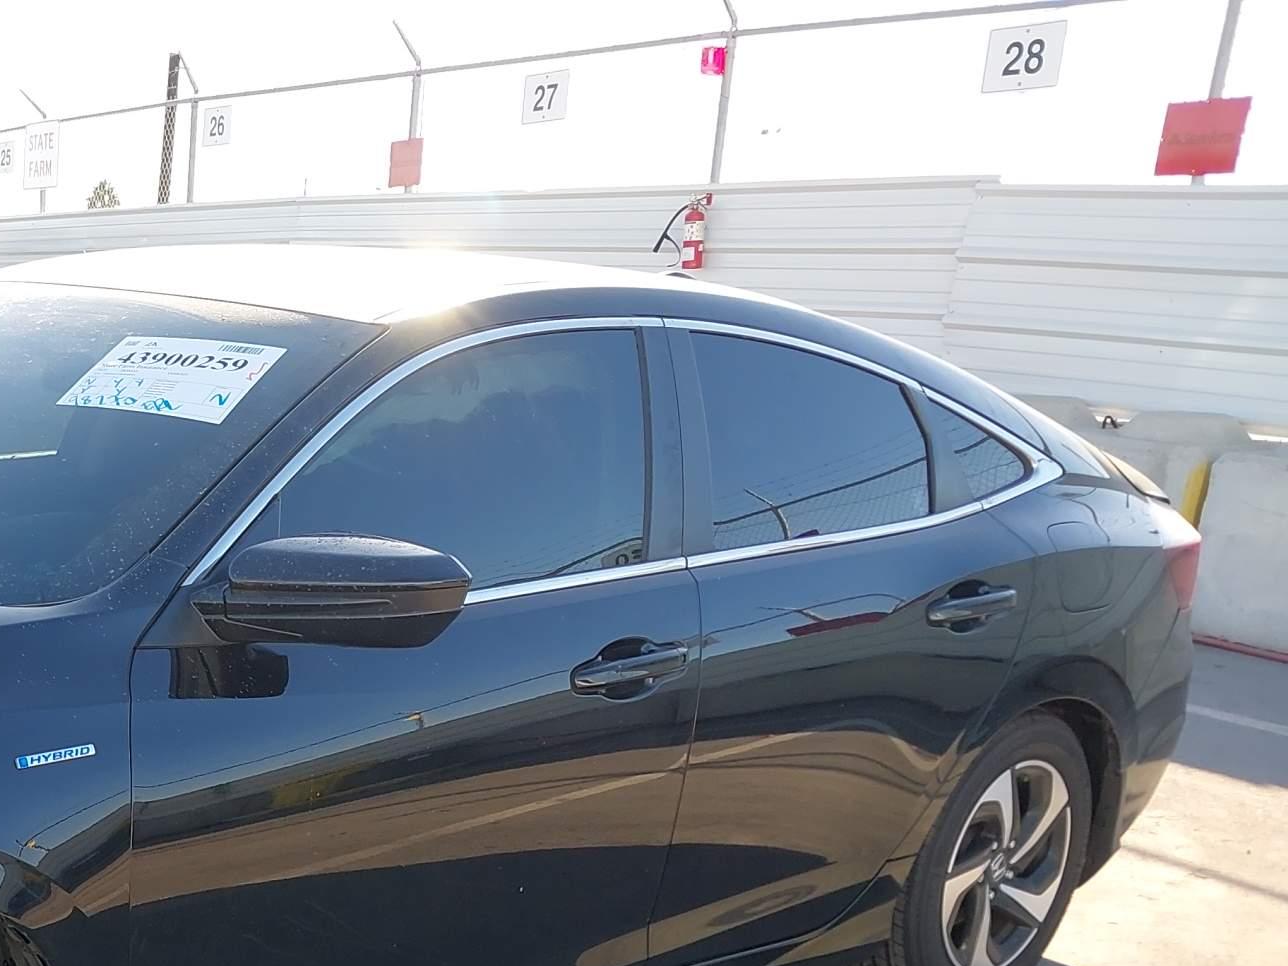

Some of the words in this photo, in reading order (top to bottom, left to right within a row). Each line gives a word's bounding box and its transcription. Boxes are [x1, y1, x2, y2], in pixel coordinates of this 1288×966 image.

[1001, 38, 1046, 77] 28
[533, 83, 559, 112] 27
[209, 115, 225, 137] 26
[29, 132, 54, 152] STATE
[0, 148, 11, 166] 25
[29, 159, 52, 178] FARM
[117, 351, 249, 372] 43900259
[30, 746, 91, 764] HYBRID
